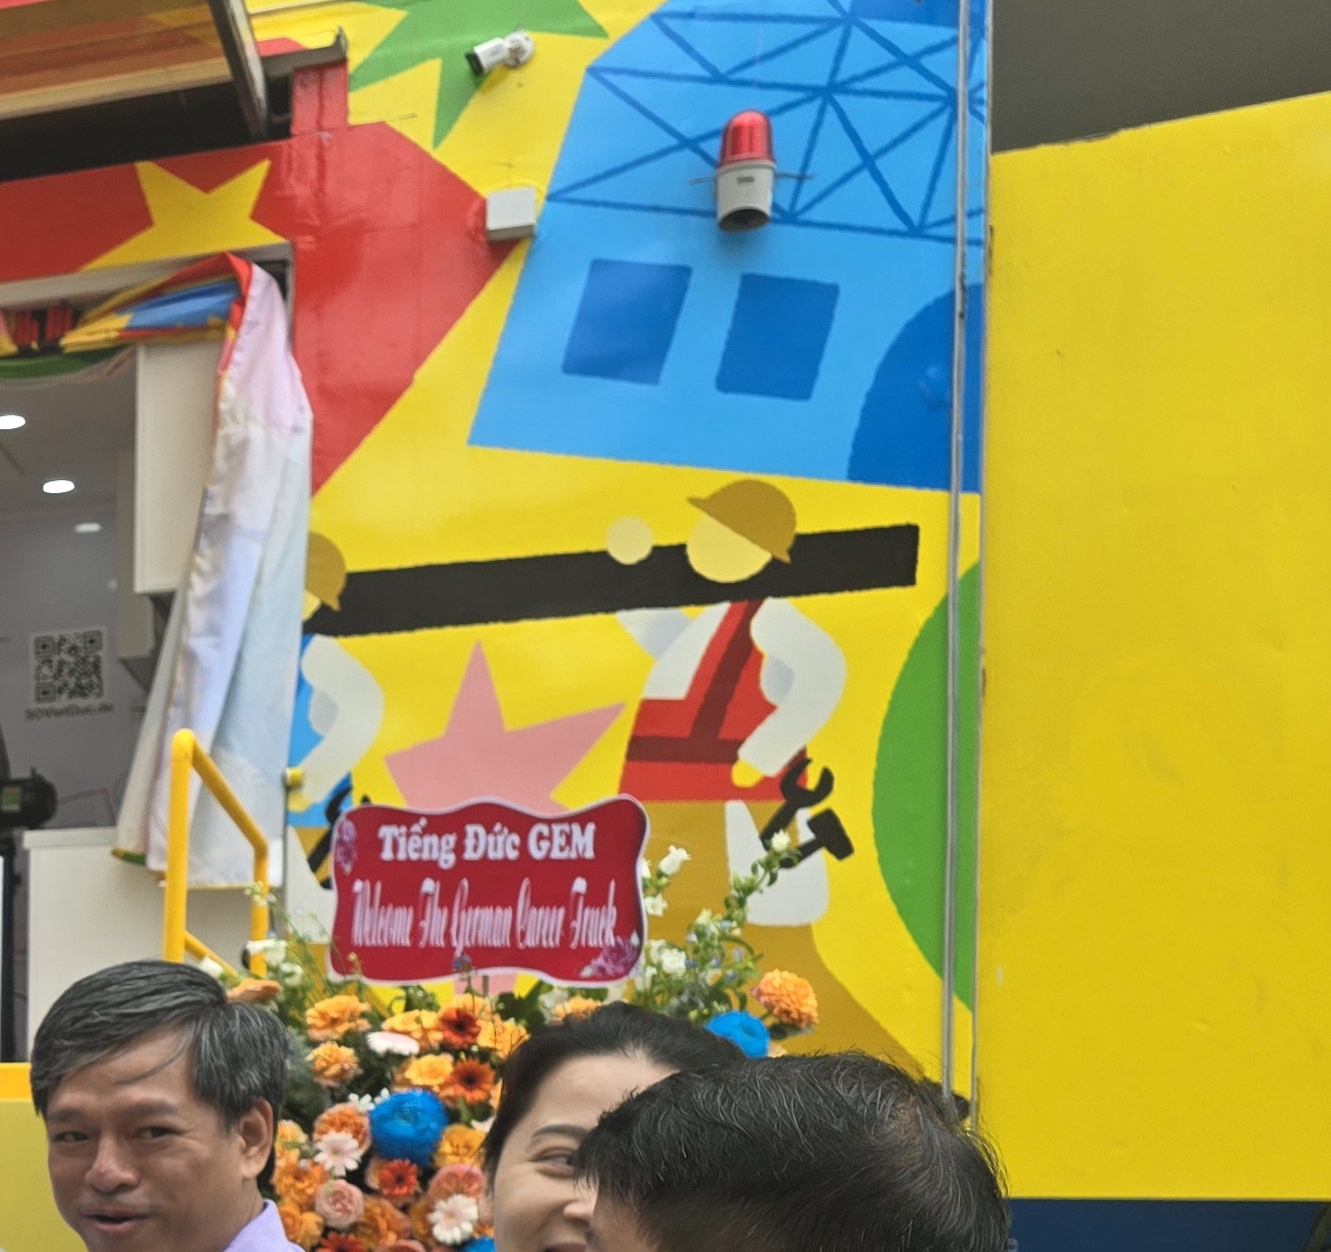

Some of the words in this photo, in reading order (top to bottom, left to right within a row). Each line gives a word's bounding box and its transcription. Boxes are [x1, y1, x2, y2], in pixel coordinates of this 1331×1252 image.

[377, 817, 457, 870] Tiếng
[462, 821, 521, 861] Đức
[527, 822, 596, 861] GEM
